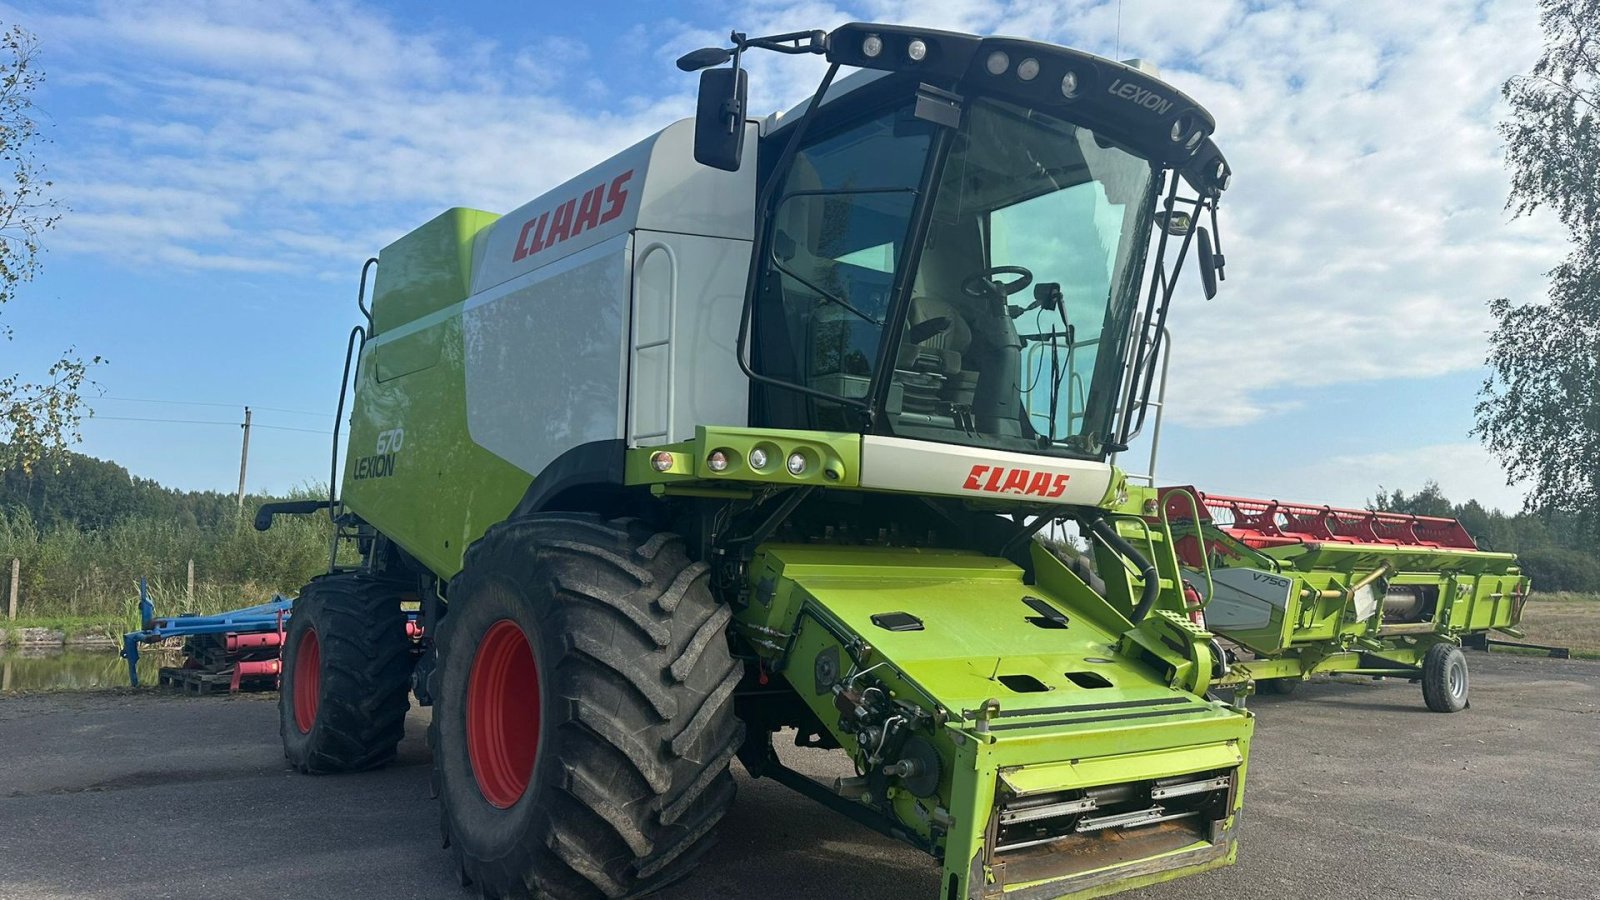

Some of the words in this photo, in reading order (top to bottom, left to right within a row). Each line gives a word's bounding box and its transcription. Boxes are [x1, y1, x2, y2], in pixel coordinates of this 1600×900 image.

[1108, 79, 1174, 115] LEXION
[512, 169, 634, 263] CLAAS
[376, 428, 404, 455] 670
[353, 453, 395, 480] LEXION
[962, 465, 1070, 497] CLAAS
